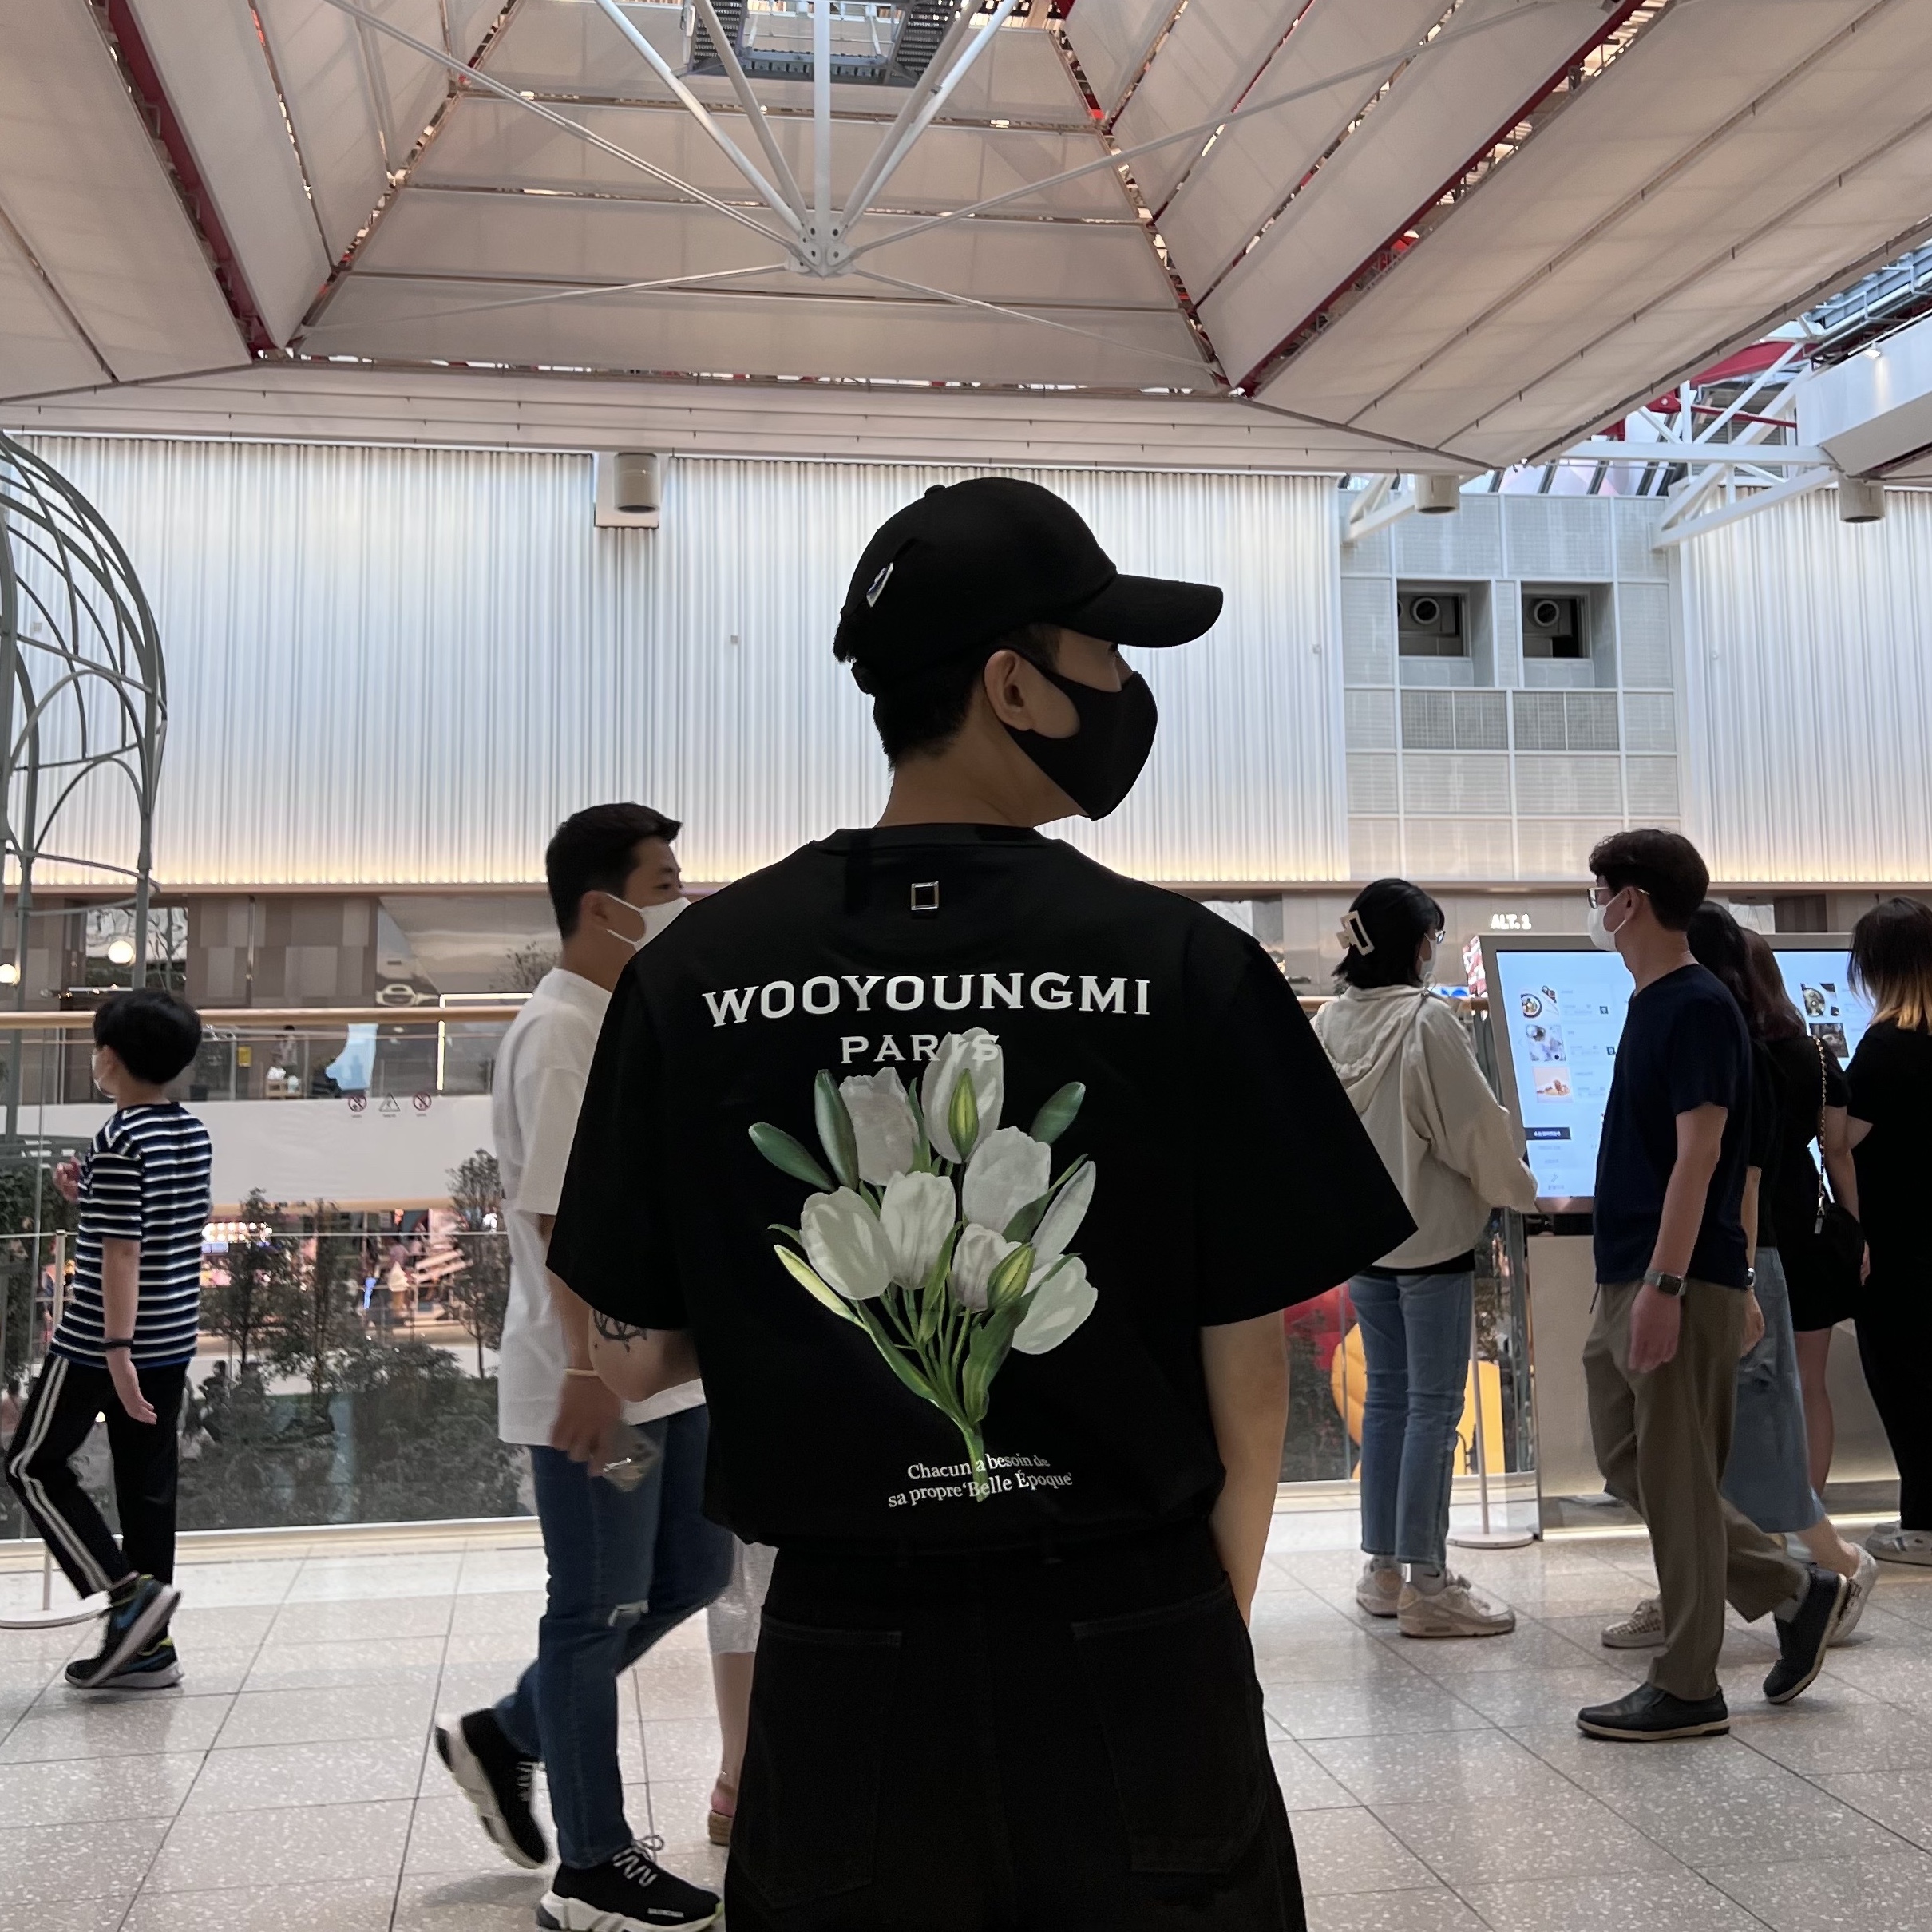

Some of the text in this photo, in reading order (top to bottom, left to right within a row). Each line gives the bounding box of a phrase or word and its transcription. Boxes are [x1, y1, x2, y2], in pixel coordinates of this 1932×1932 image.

[702, 972, 1150, 1027] WOOYOUNGMI
[840, 1034, 999, 1063] PARIS
[908, 1453, 1050, 1479] Chacun a besoin de
[888, 1492, 908, 1507] sa
[909, 1484, 963, 1506] propre
